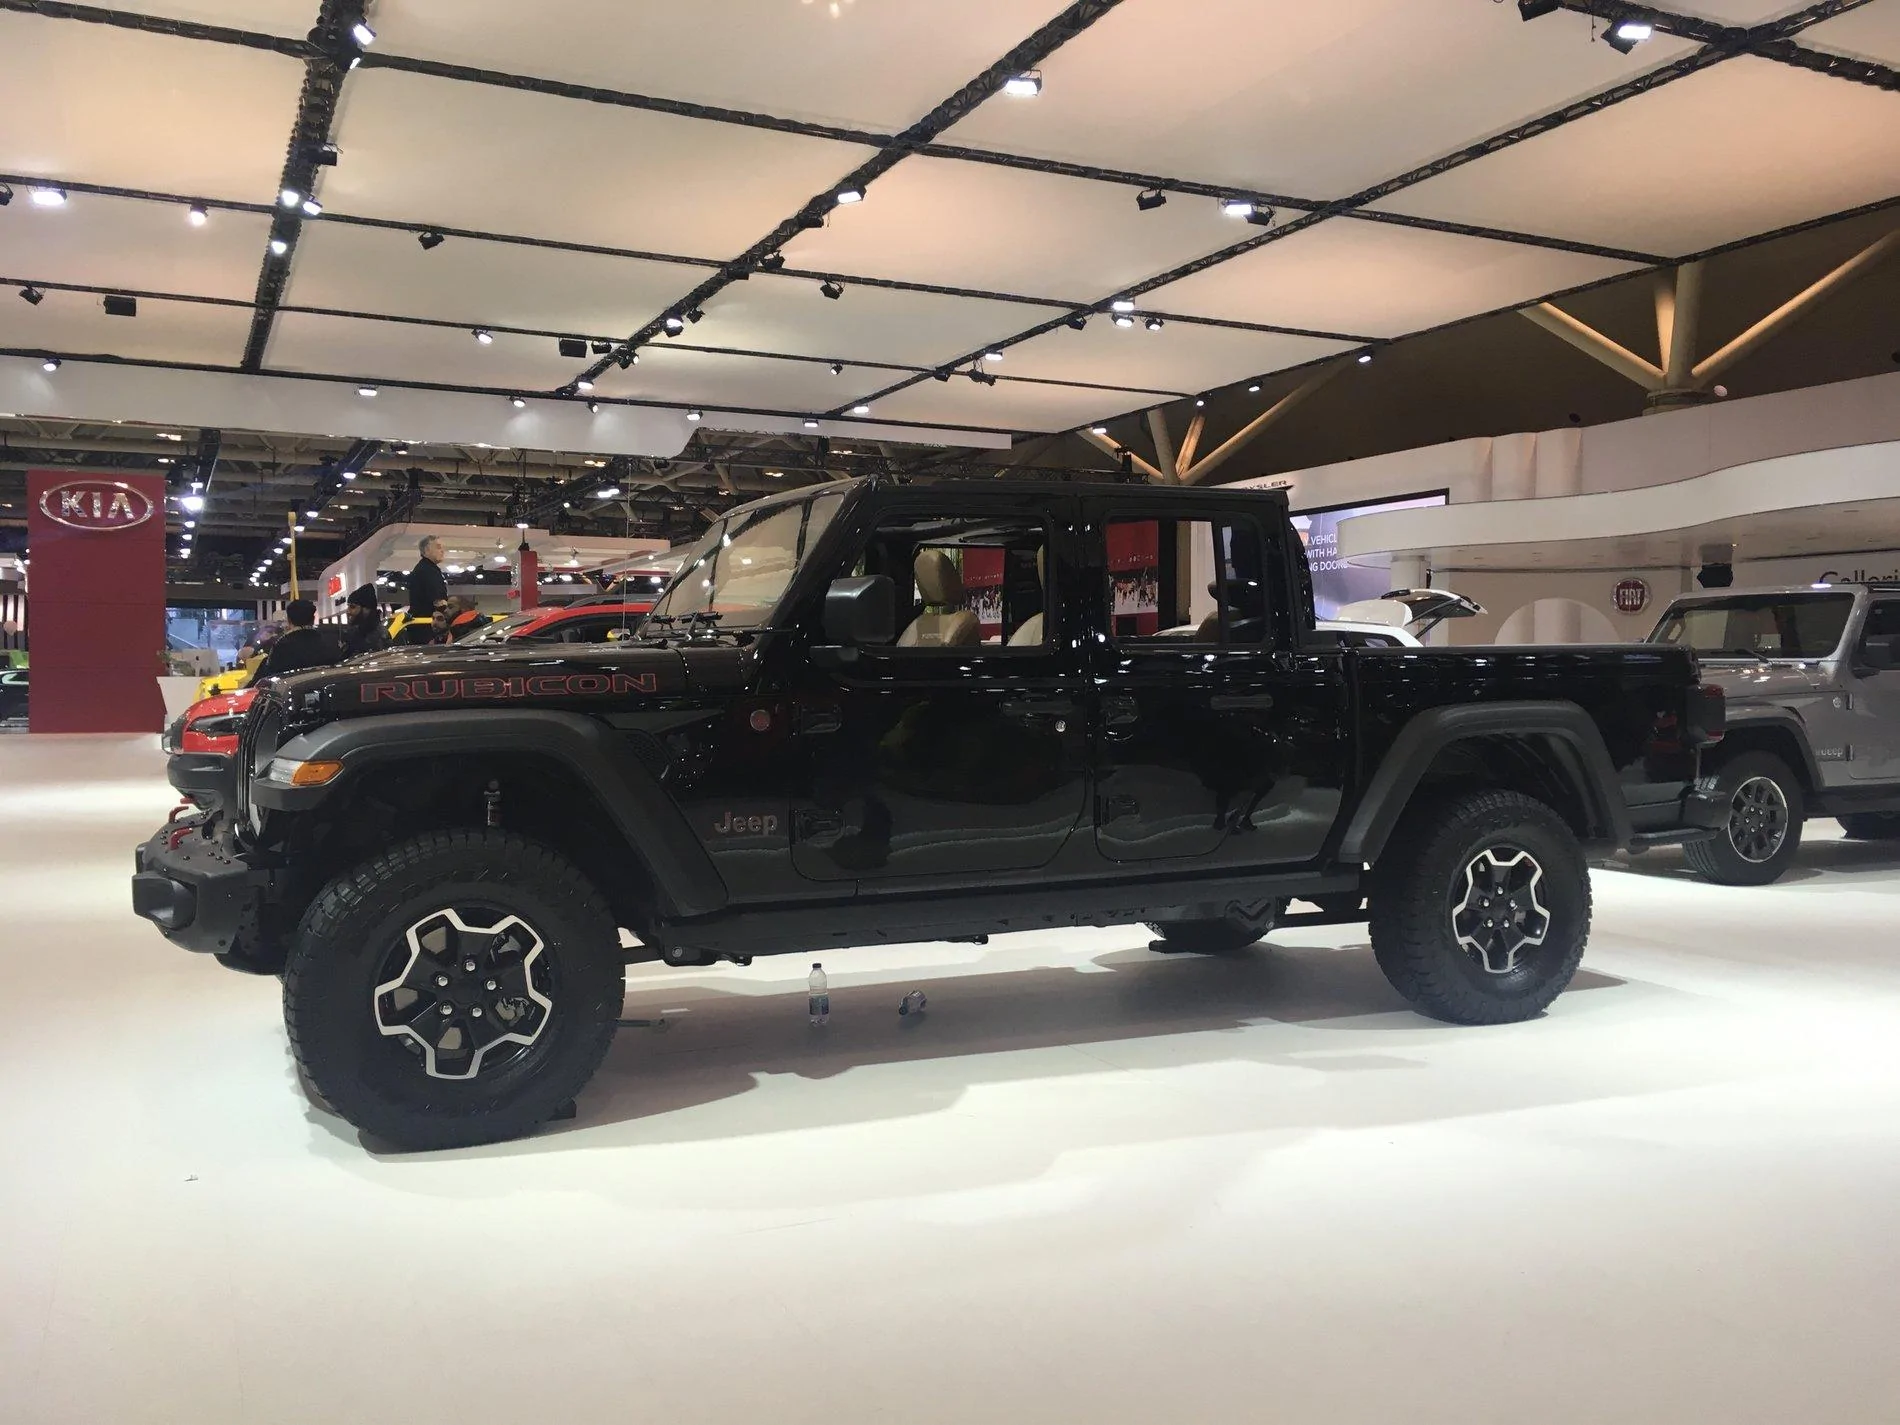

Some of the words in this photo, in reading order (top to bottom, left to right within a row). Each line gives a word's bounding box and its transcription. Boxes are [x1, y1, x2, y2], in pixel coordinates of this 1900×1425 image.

[60, 490, 135, 519] KIA
[1619, 588, 1644, 605] FIAT
[360, 673, 657, 702] RUBICON
[713, 811, 778, 837] Jeep
